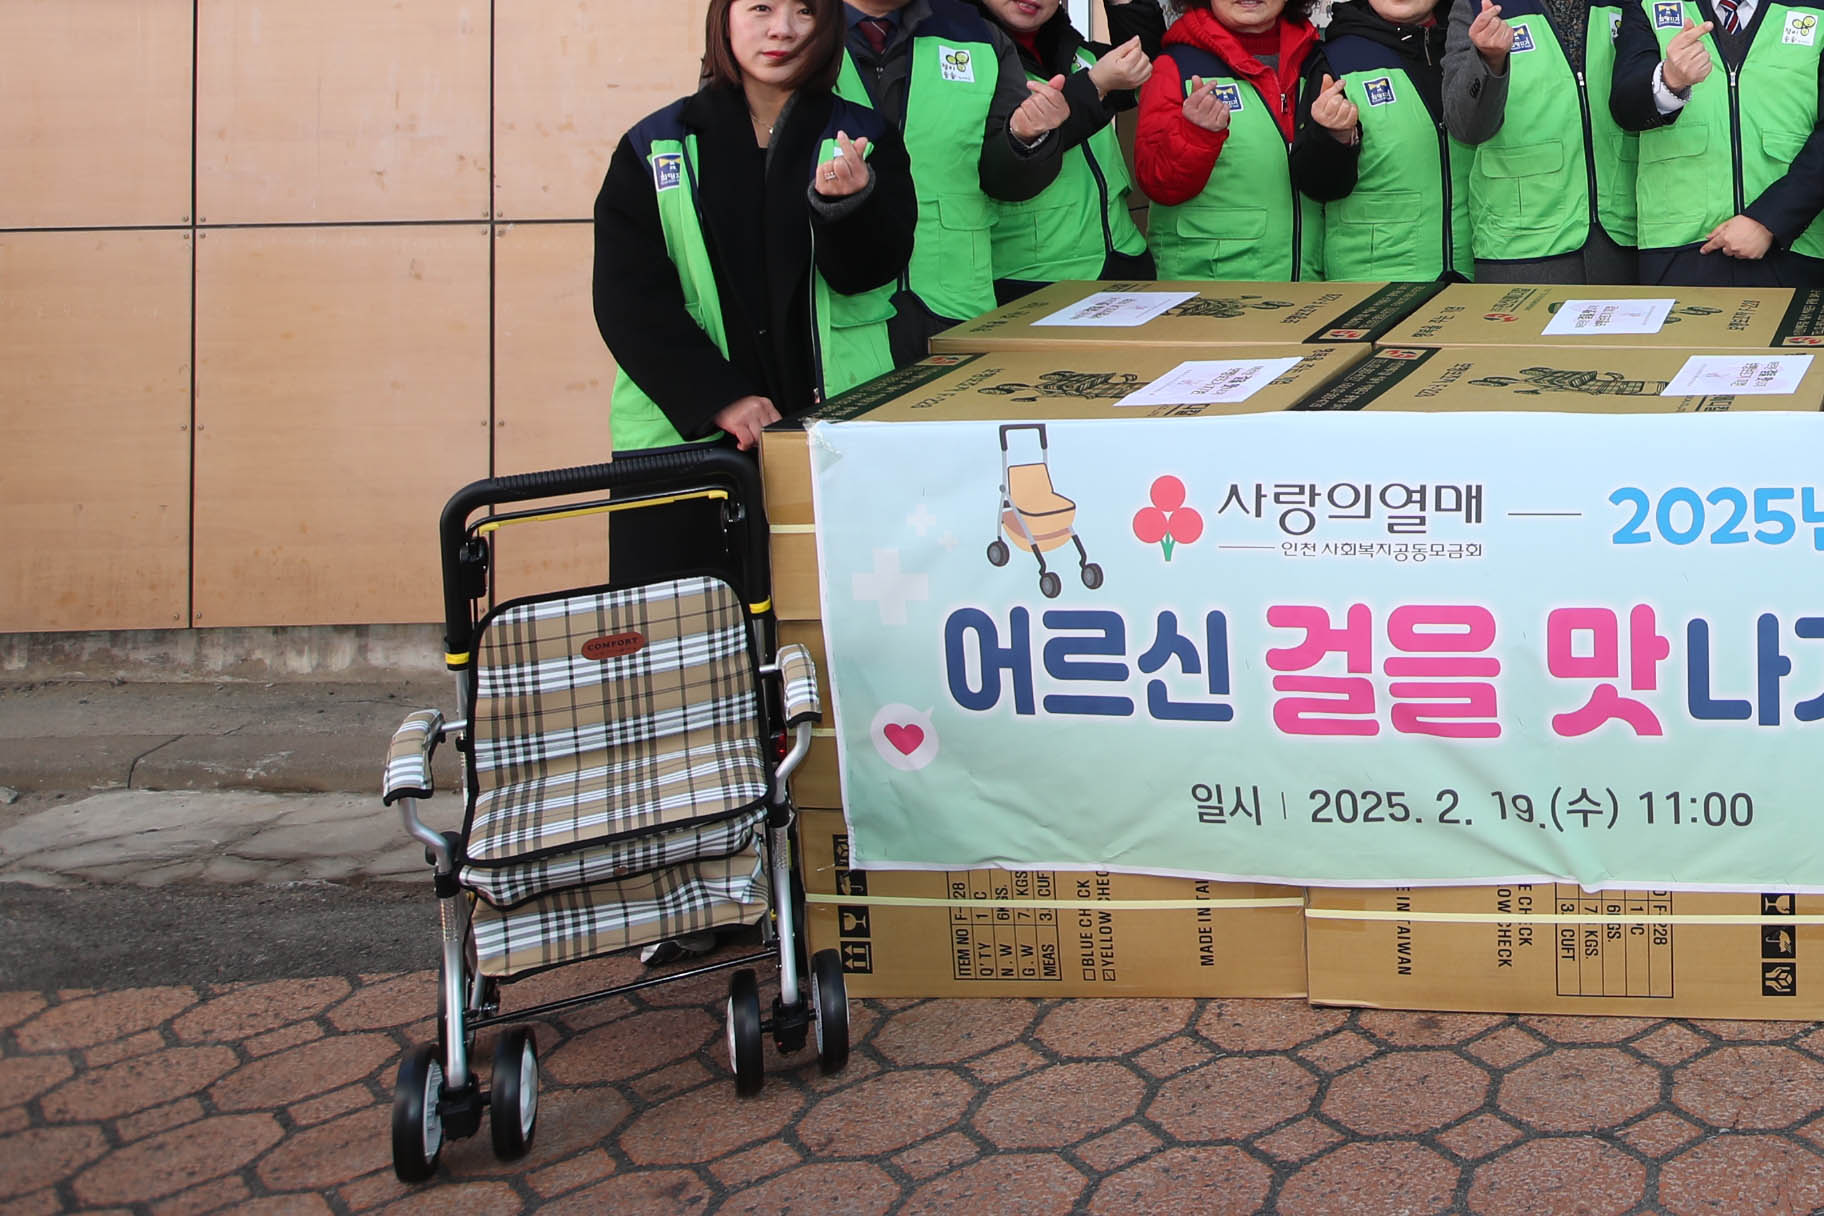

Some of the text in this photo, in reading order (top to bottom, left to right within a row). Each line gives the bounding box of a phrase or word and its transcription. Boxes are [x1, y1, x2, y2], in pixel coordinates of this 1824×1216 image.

[1216, 481, 1484, 535] 사랑의열매
[1281, 541, 1483, 562] 인천 사회복지공동모금회
[587, 636, 639, 651] COMFORT
[943, 605, 1235, 723] 어르신
[1264, 602, 1503, 739] 걸을
[1190, 784, 1263, 826] 일시
[1308, 788, 1424, 825] 2025.
[1436, 788, 1474, 825] 2.
[1638, 790, 1755, 828] 11:00
[1037, 871, 1050, 897] CUF
[1197, 908, 1212, 921] IN
[1396, 896, 1410, 911] IN
[952, 882, 971, 976] ITEM NO F-28
[1077, 880, 1095, 966] BLUE CHCK
[1099, 912, 1114, 966] YELLOW
[1607, 904, 1621, 942] 6GS.
[1041, 944, 1057, 976] MEAS
[1198, 927, 1214, 966] MADE
[1561, 929, 1575, 961] CUFT
[1585, 930, 1599, 959] KGS.
